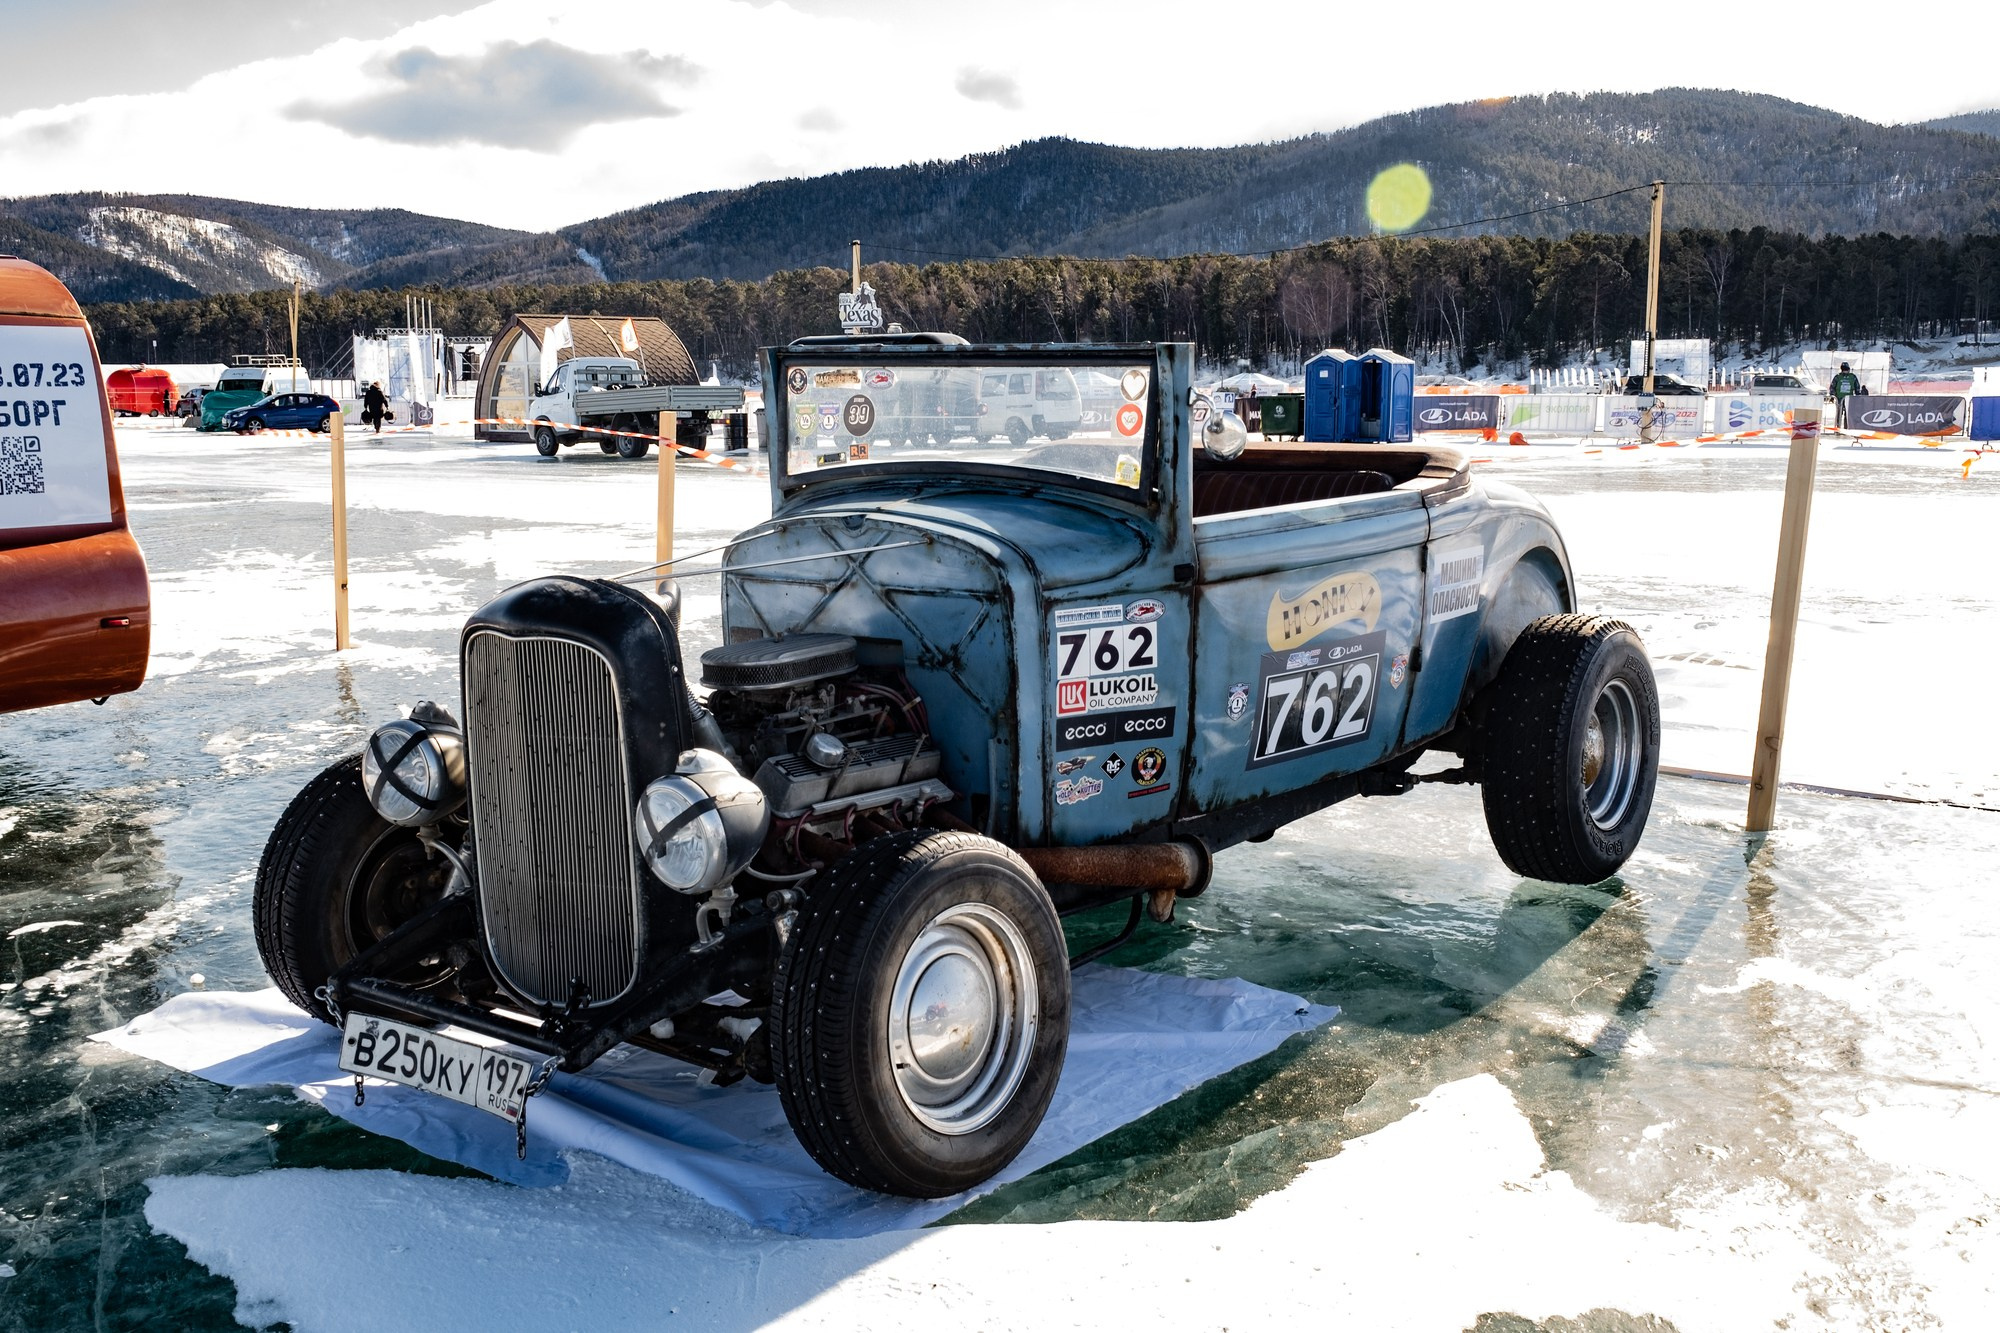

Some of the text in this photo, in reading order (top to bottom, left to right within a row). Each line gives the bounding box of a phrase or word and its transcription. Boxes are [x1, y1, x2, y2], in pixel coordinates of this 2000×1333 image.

[840, 305, 880, 327] Texas
[0, 363, 86, 388] .07.23
[848, 404, 870, 425] 39
[1454, 411, 1488, 422] LADA
[1545, 404, 1591, 415] ЭКОЛОГИЯ
[1907, 412, 1945, 424] LADA
[1440, 557, 1477, 587] МАШИНА
[1432, 583, 1481, 616] ОПАСНОСТИ
[1059, 626, 1154, 677] 762
[1346, 645, 1363, 655] LADA
[1089, 676, 1157, 697] LUKOIL
[1089, 693, 1155, 708] OIL COMPANY
[1264, 662, 1373, 755] 762
[1065, 717, 1167, 740] ecco ecco
[483, 1055, 524, 1099] 197
[488, 1093, 508, 1112] RUS
